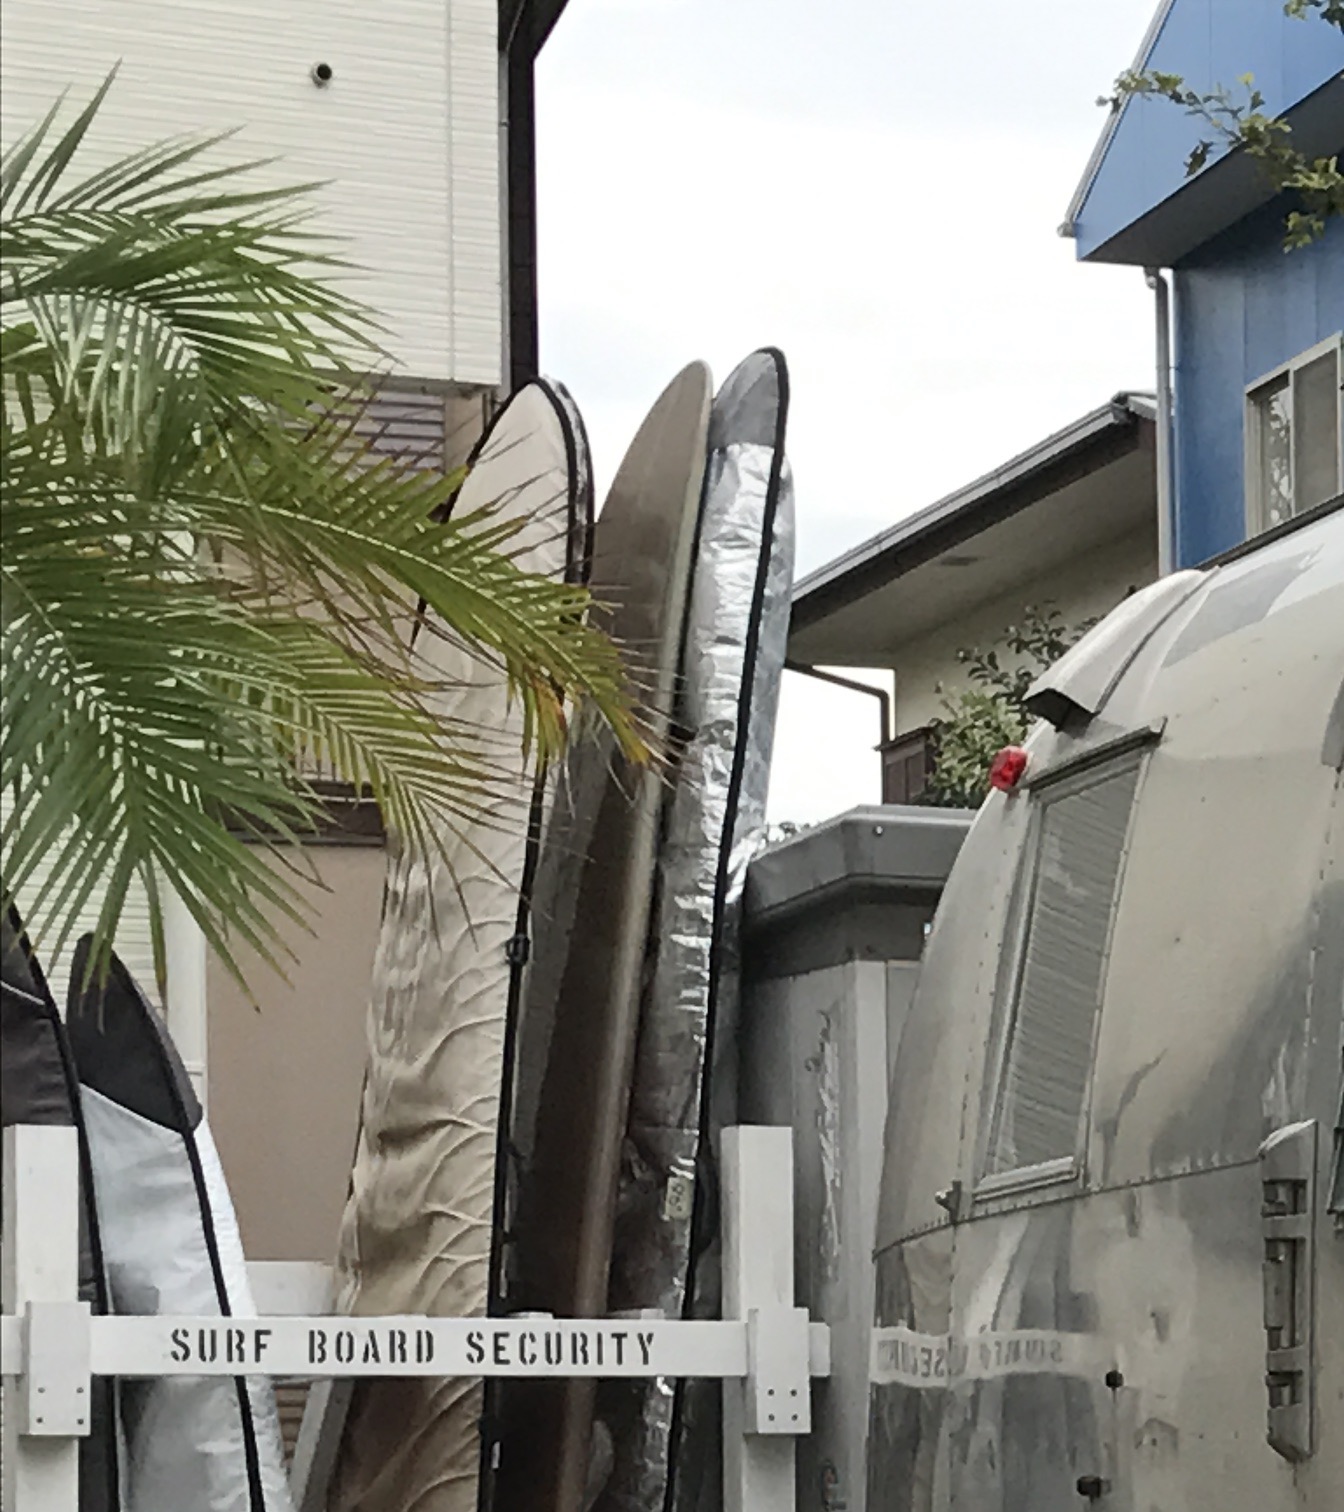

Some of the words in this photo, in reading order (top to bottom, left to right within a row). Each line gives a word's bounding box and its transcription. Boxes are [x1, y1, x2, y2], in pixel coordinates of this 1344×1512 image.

[169, 1328, 273, 1364] SURF
[307, 1329, 436, 1365] BOARD
[464, 1331, 657, 1366] SECURITY
